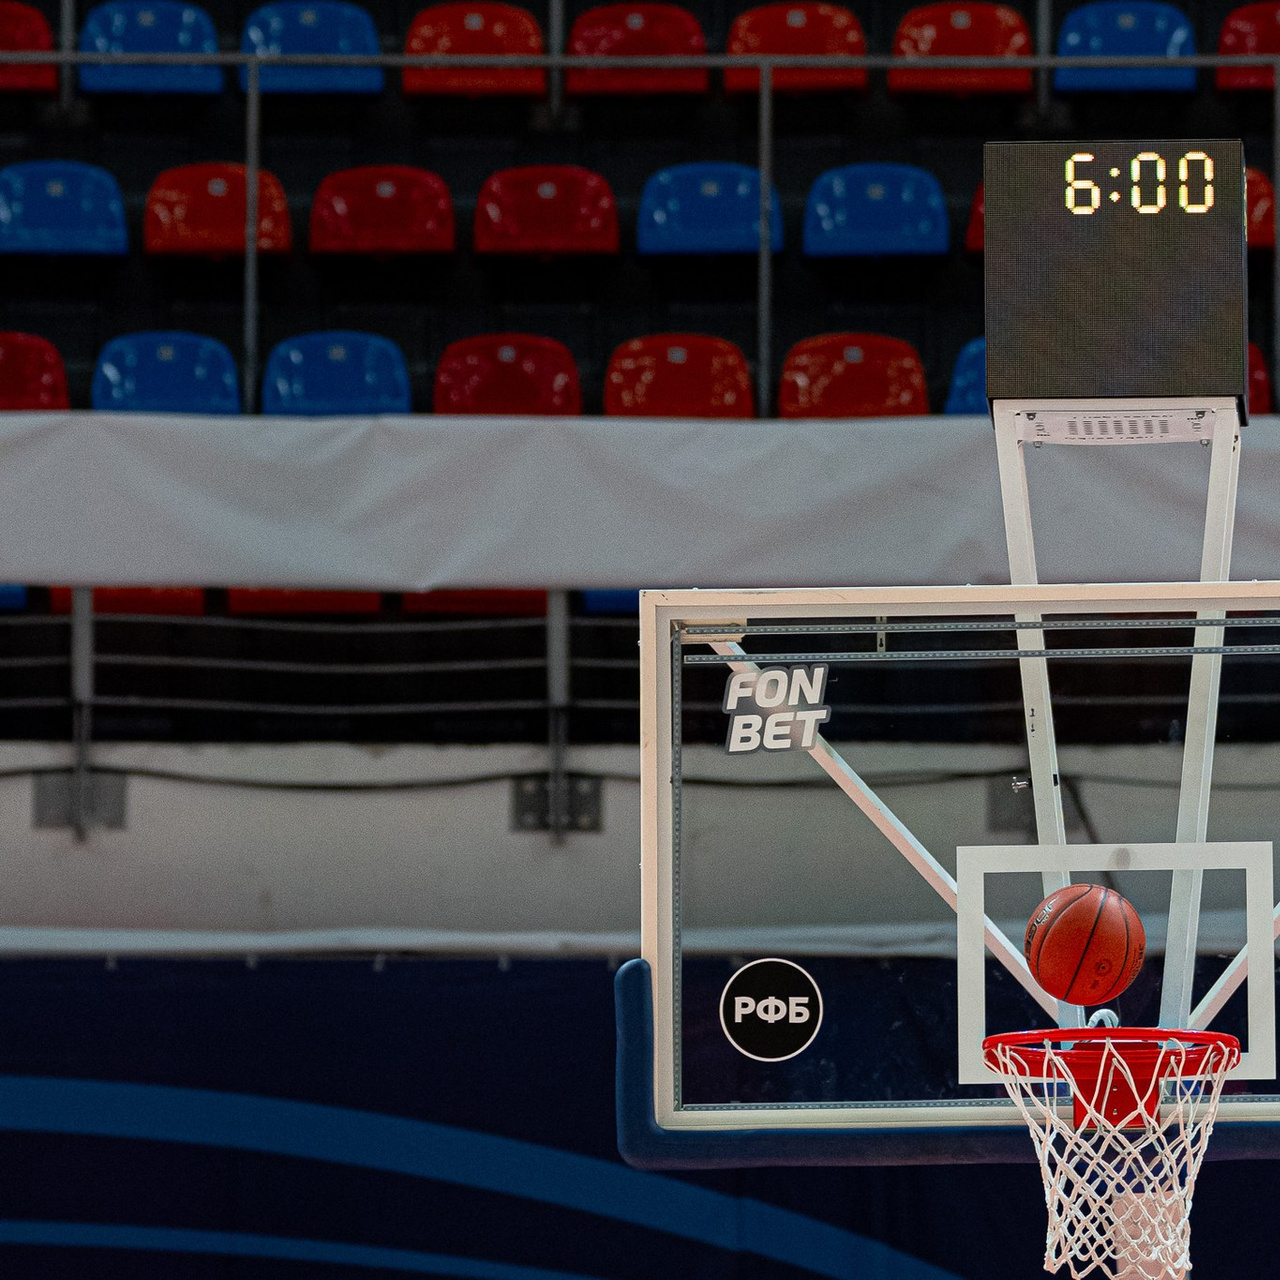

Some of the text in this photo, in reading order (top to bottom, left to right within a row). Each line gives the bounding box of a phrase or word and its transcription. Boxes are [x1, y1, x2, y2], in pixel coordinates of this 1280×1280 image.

[1064, 150, 1215, 215] 6:00
[726, 667, 824, 710] FON
[728, 709, 827, 752] BET
[734, 996, 810, 1024] РФБ
